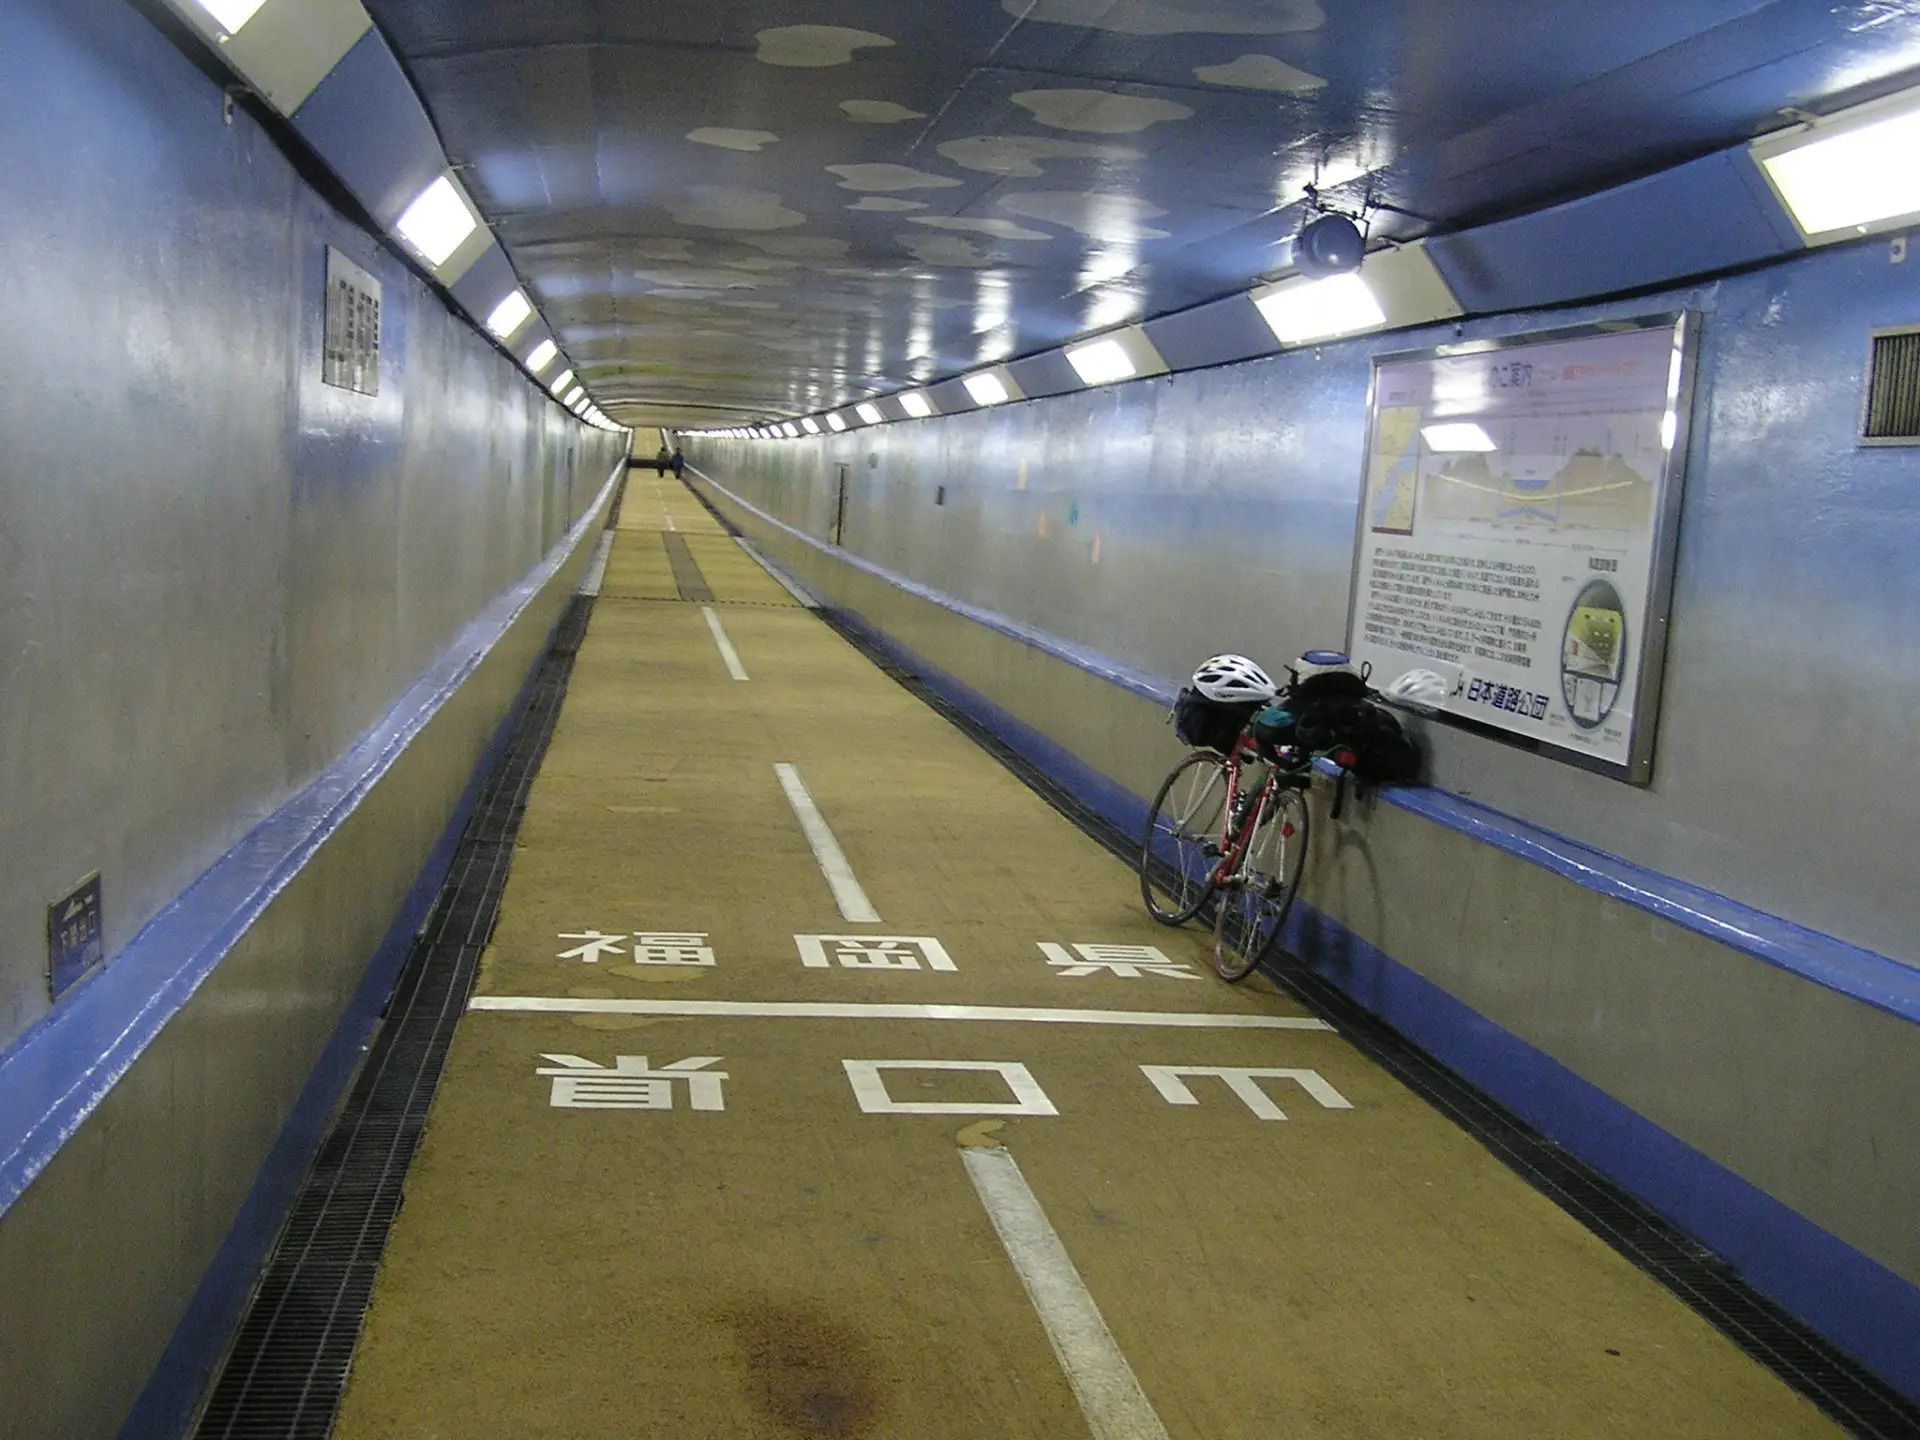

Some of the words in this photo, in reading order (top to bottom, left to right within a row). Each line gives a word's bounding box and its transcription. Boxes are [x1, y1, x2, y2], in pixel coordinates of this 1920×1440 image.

[1467, 677, 1549, 720] 日本道路公団
[557, 930, 1201, 980] 福岡県
[535, 1053, 1353, 1121] 山口県
